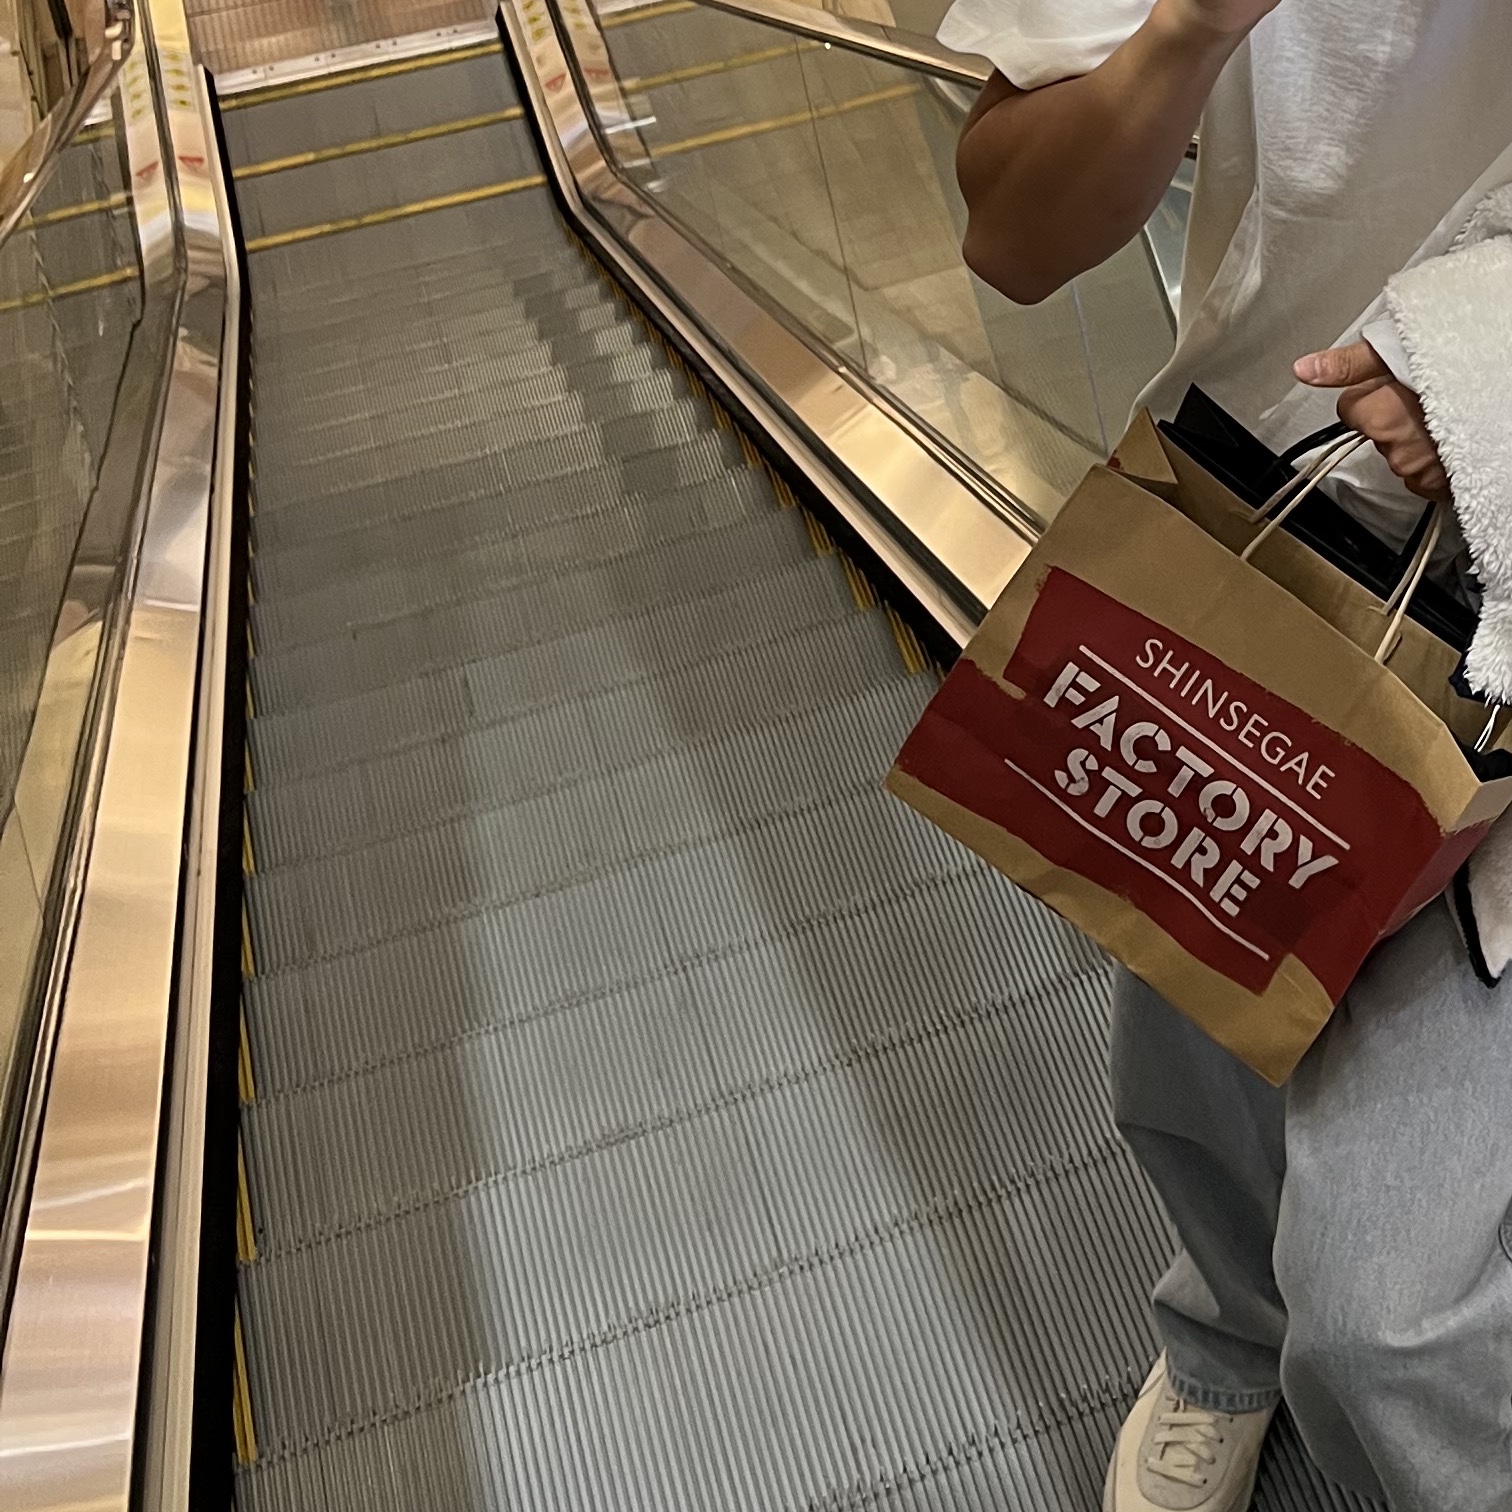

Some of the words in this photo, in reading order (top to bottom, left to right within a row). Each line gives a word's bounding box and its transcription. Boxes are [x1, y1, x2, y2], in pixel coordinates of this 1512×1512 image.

[1043, 661, 1339, 889] FACTORY
[1135, 638, 1336, 800] SHINSEGAE
[1054, 748, 1261, 917] STORE
